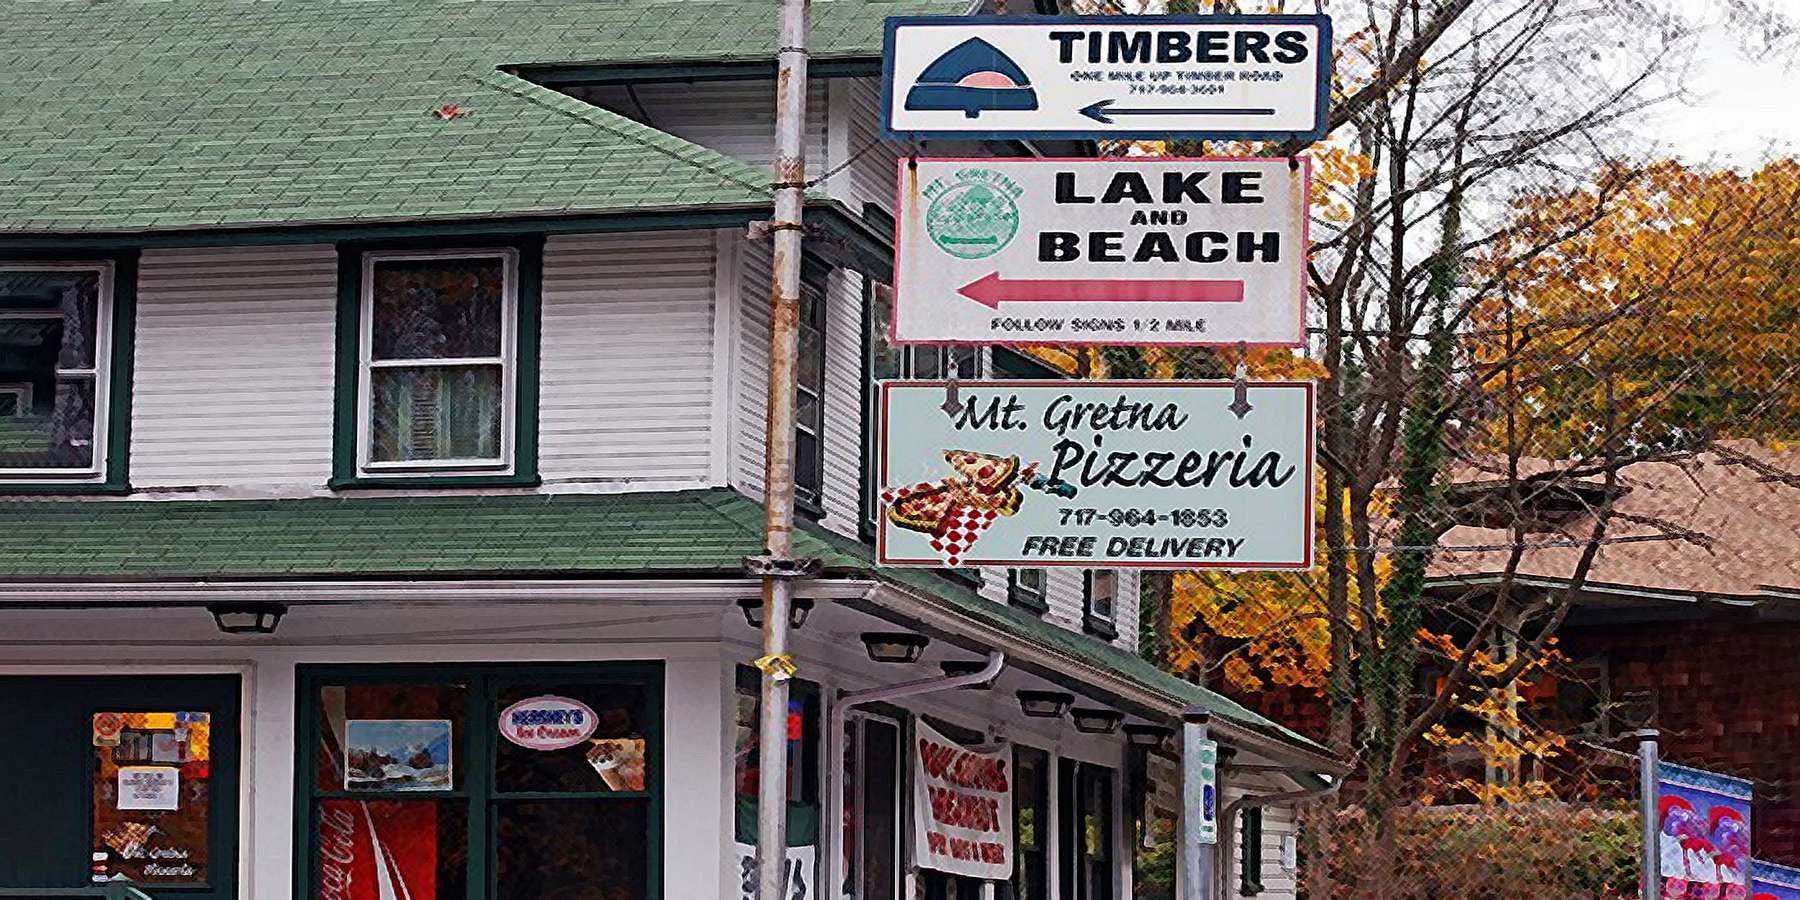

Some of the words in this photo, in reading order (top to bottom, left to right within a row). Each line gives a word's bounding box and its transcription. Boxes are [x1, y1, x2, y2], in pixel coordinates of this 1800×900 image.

[1049, 31, 1308, 64] TIMBERS
[1054, 171, 1265, 205] LAKE
[1130, 210, 1188, 226] AND
[1038, 231, 1280, 263] BEACH
[990, 317, 1065, 332] FOLLOW
[1070, 317, 1126, 333] SIGNS
[1165, 318, 1208, 333] MILE
[955, 395, 1027, 432] Mt.
[1043, 394, 1188, 436] Gretna
[1050, 434, 1296, 488] Pizzeria
[1021, 536, 1097, 557] FREE
[1106, 537, 1245, 557] DELIVERY
